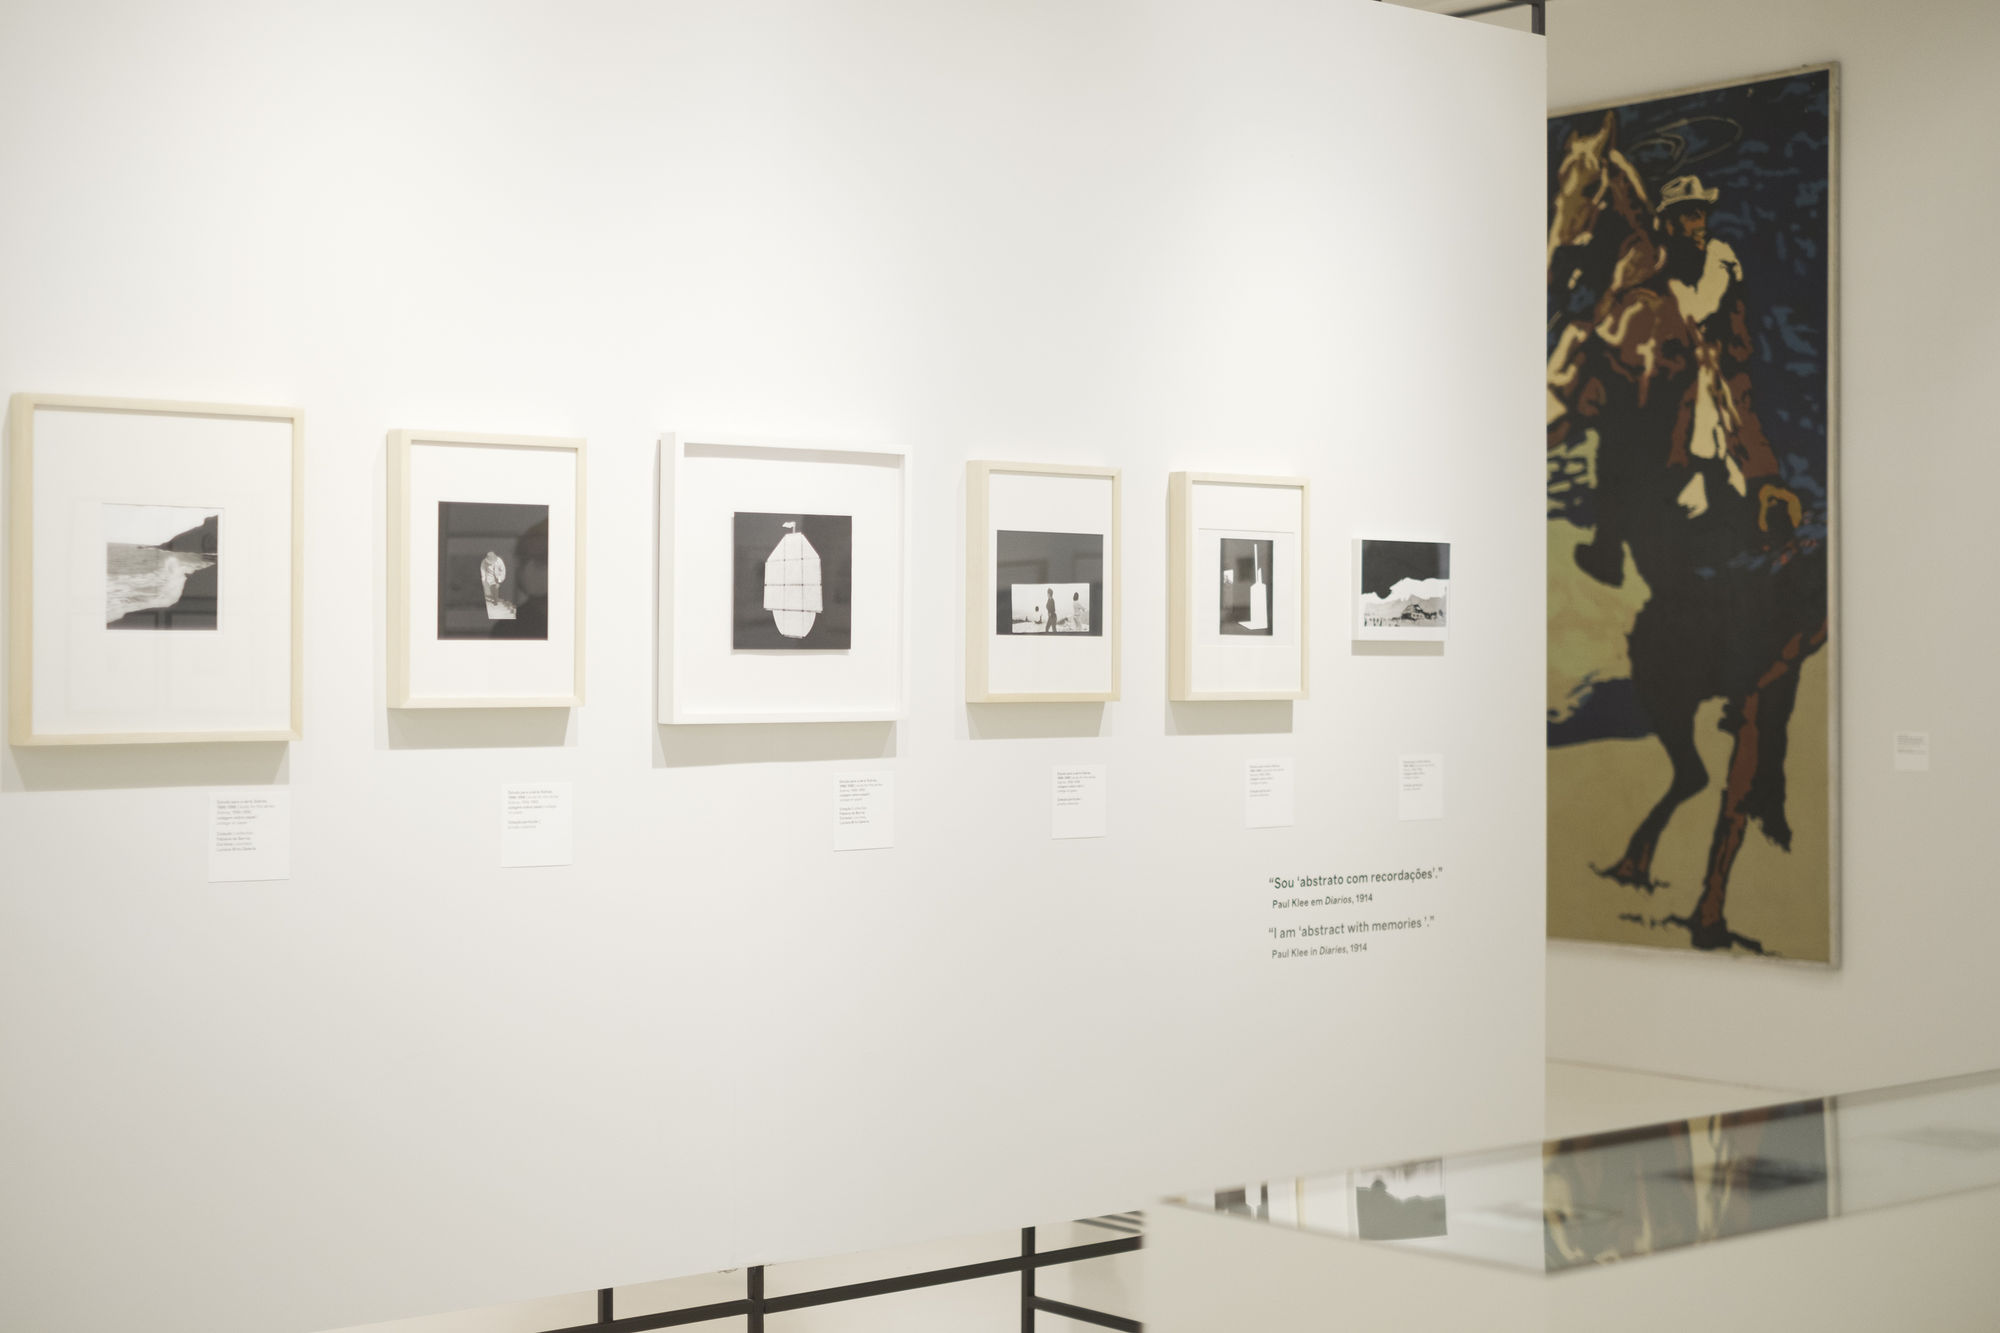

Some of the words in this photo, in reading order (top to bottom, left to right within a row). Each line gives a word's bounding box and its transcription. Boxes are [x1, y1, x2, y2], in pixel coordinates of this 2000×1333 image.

[1297, 874, 1344, 888] 'abstrato
[1346, 875, 1369, 885] com
[1272, 898, 1290, 909] Paul
[1291, 897, 1309, 908] Klee
[1310, 898, 1323, 907] em
[1356, 893, 1373, 903] 1914
[1279, 928, 1296, 939] am
[1298, 922, 1345, 937] 'abstract
[1347, 921, 1369, 934] with
[1271, 949, 1289, 960] Paul
[1291, 947, 1309, 958] Klee
[1310, 947, 1318, 956] in
[1350, 943, 1368, 953] 1914
